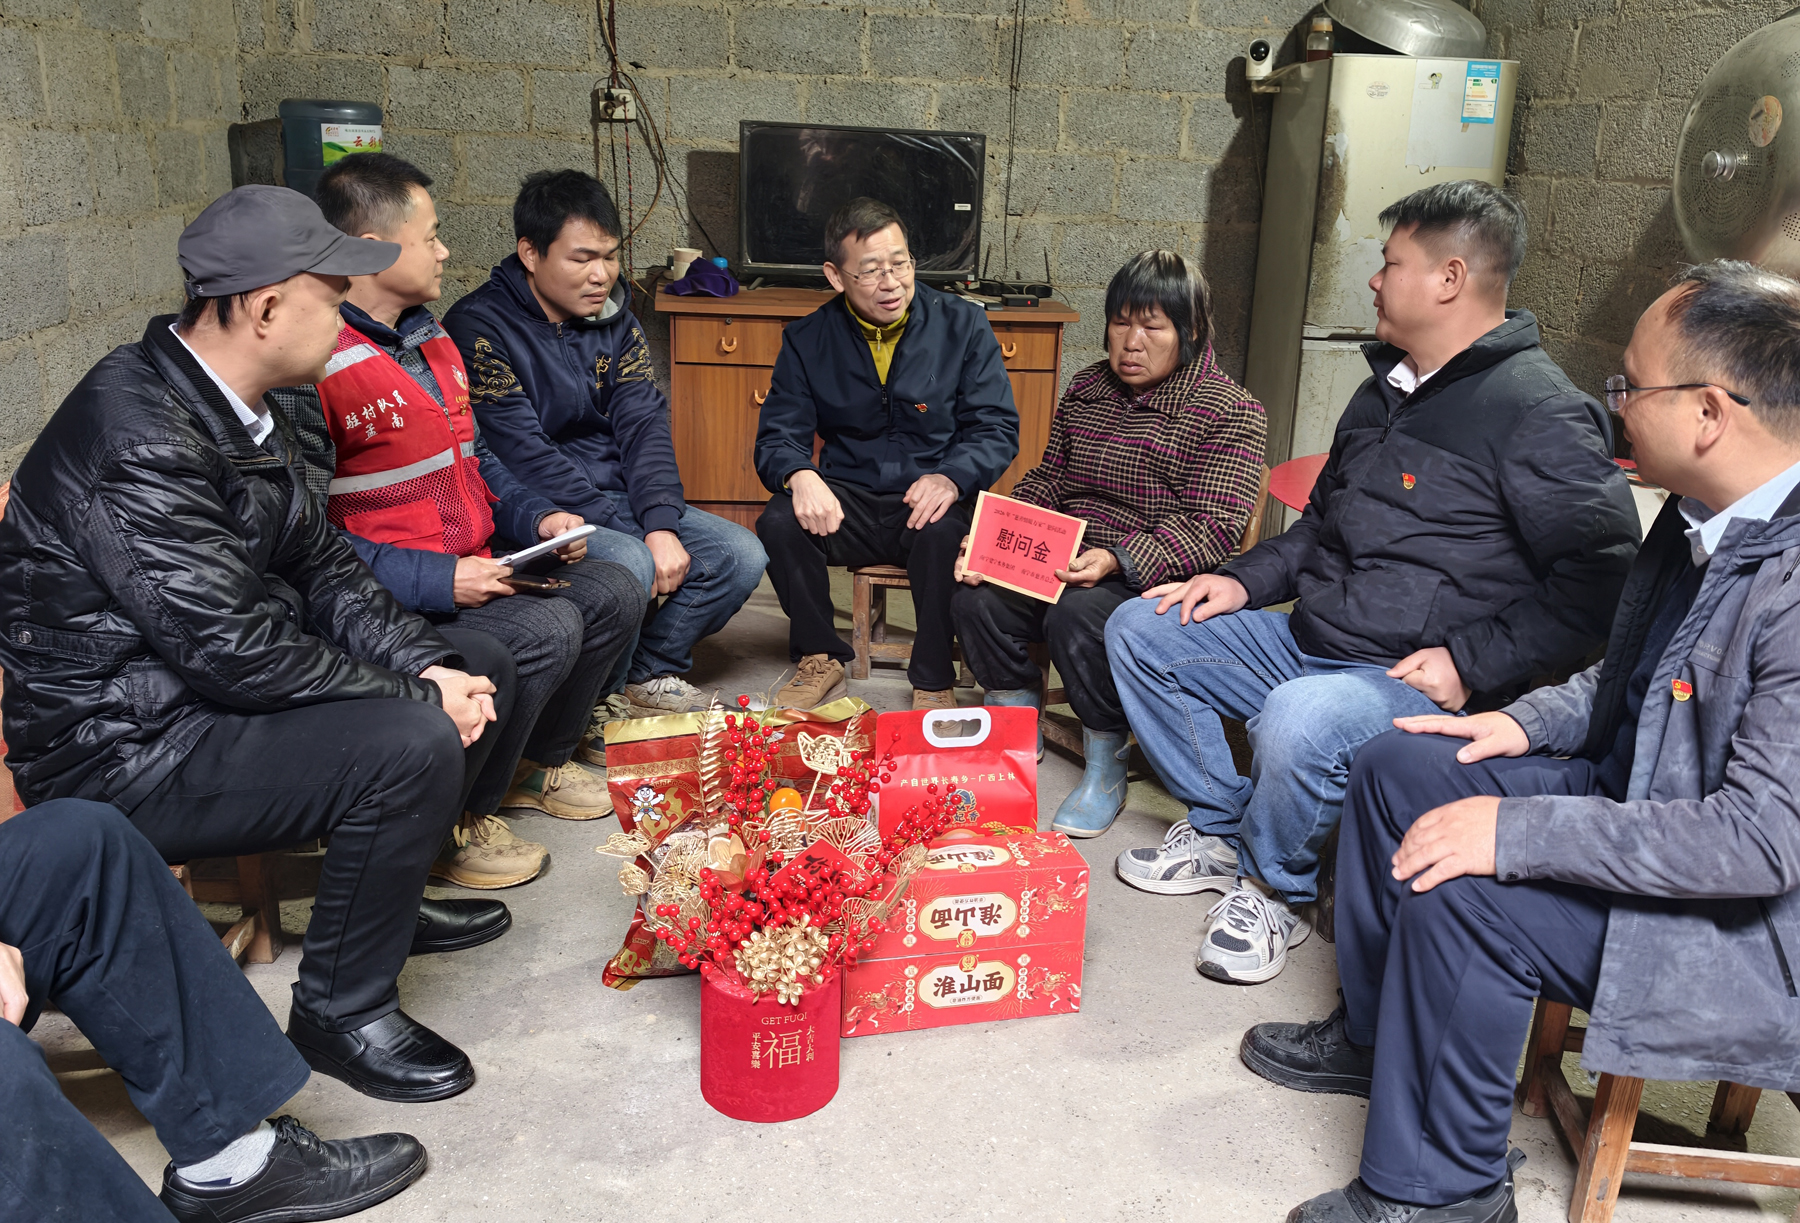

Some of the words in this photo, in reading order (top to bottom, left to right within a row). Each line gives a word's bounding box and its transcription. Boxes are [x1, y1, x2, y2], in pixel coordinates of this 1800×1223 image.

[345, 390, 407, 429] 驻村队员
[995, 528, 1051, 564] 慰问金
[930, 903, 1002, 929] 淮山面
[933, 971, 1005, 998] 淮山面
[761, 1016, 782, 1025] GET
[784, 1012, 807, 1024] FUQI
[762, 1029, 803, 1069] 福
[806, 1025, 815, 1062] 大吉大利
